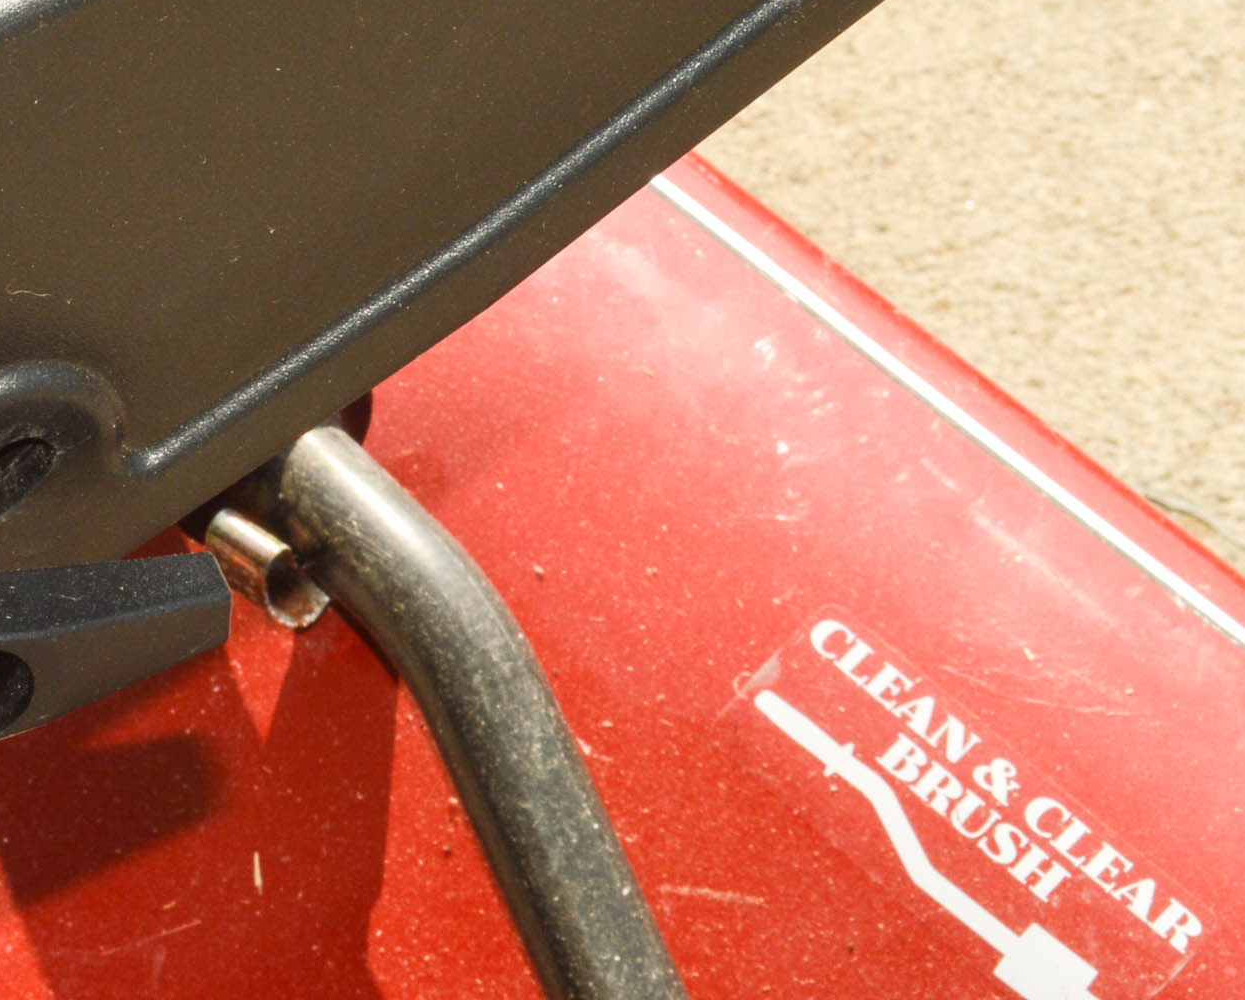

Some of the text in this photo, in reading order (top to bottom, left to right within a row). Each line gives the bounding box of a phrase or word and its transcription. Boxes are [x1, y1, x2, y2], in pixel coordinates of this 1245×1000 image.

[810, 619, 1203, 955] CLEAN & CLEAR
[876, 733, 1071, 903] BRUSH
